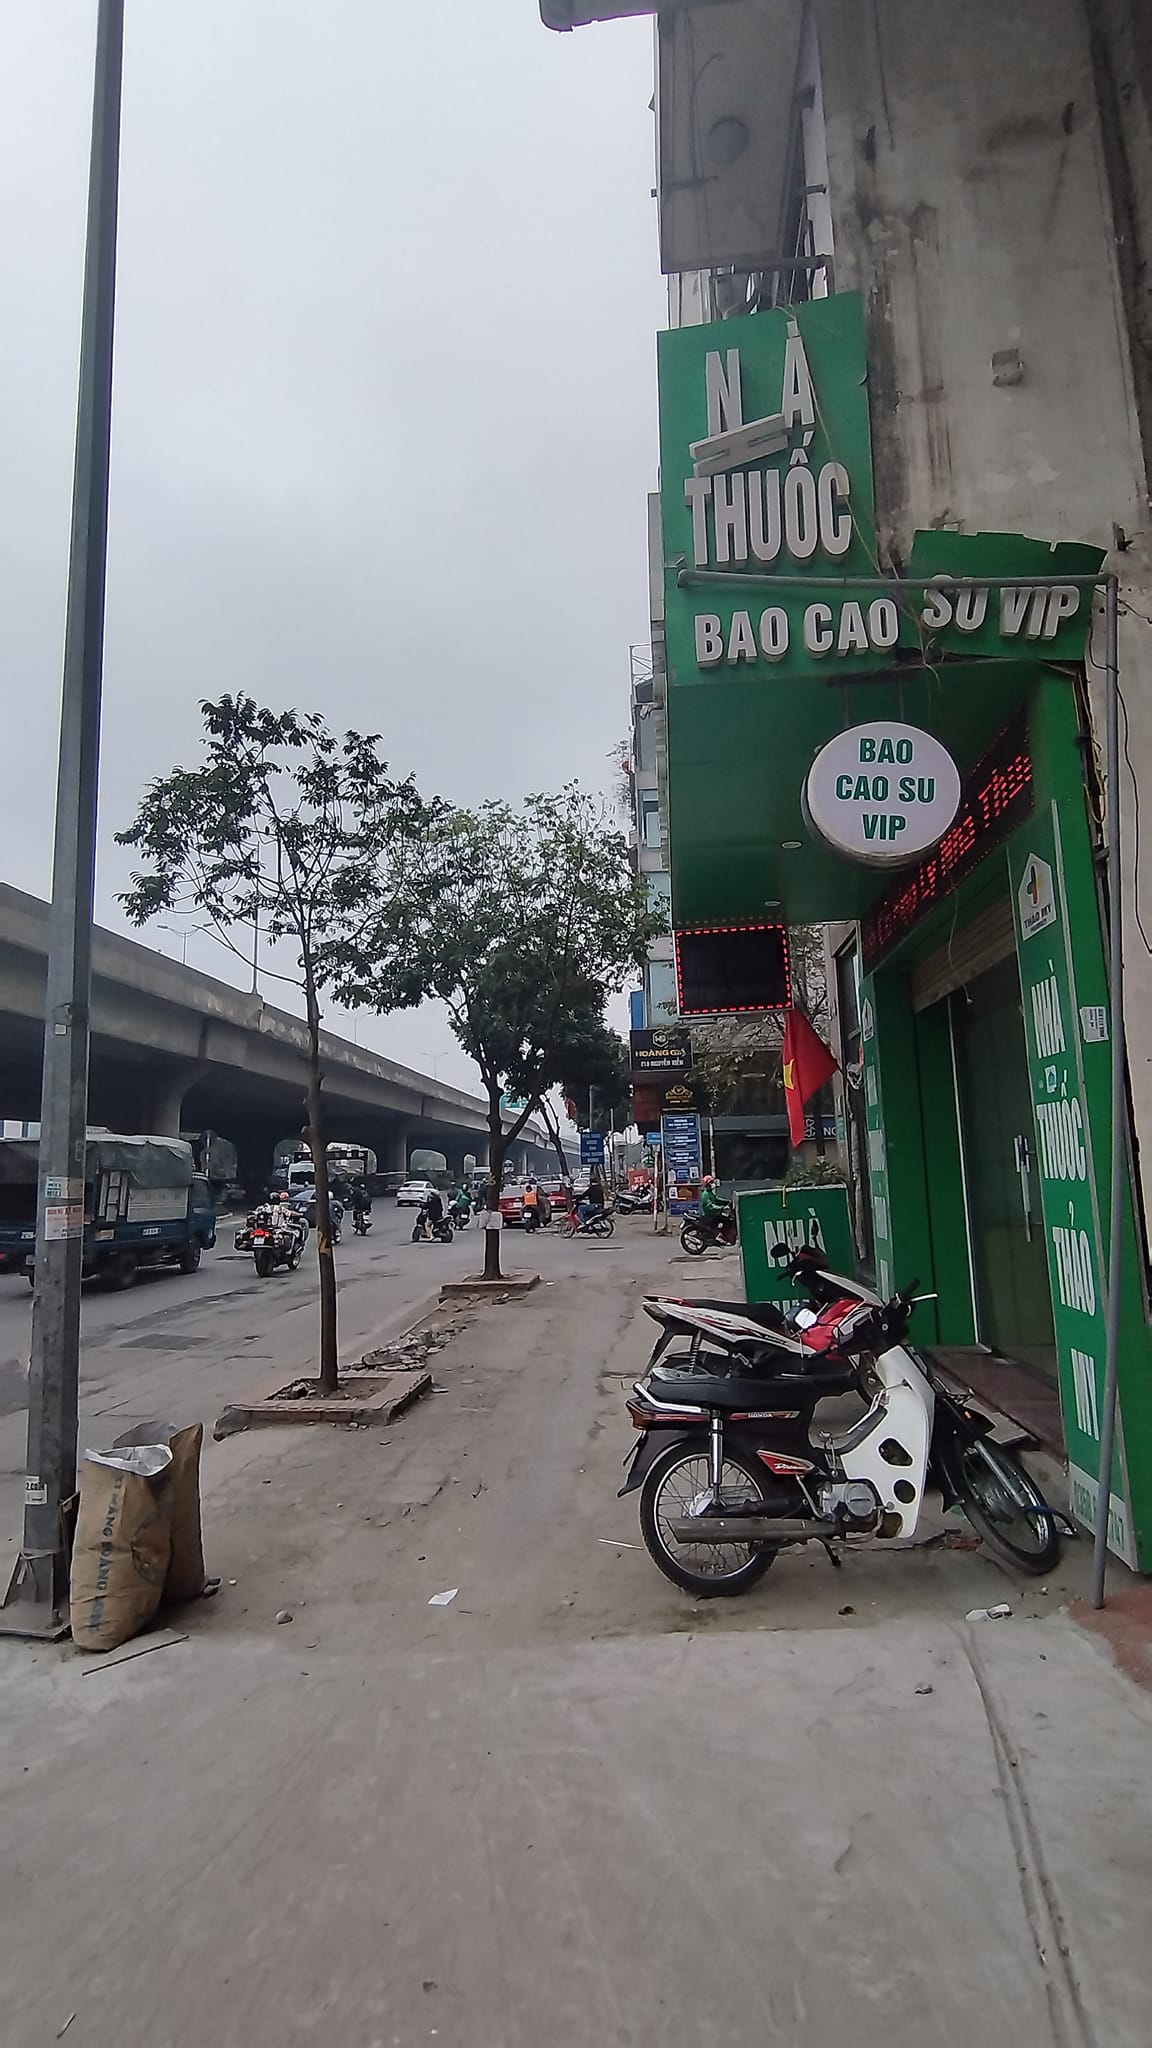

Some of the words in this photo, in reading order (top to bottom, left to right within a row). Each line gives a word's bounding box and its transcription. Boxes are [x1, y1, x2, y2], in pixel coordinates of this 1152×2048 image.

[685, 431, 852, 566] THUỐC
[695, 607, 789, 665] BAO
[803, 599, 900, 655] CAO
[923, 575, 989, 631] SU
[1000, 586, 1080, 638] VIP
[860, 738, 913, 764] BAO
[836, 775, 889, 801] CAO
[899, 777, 935, 803] SU
[862, 813, 906, 840] VIP
[1036, 1069, 1086, 1181] THUỐC
